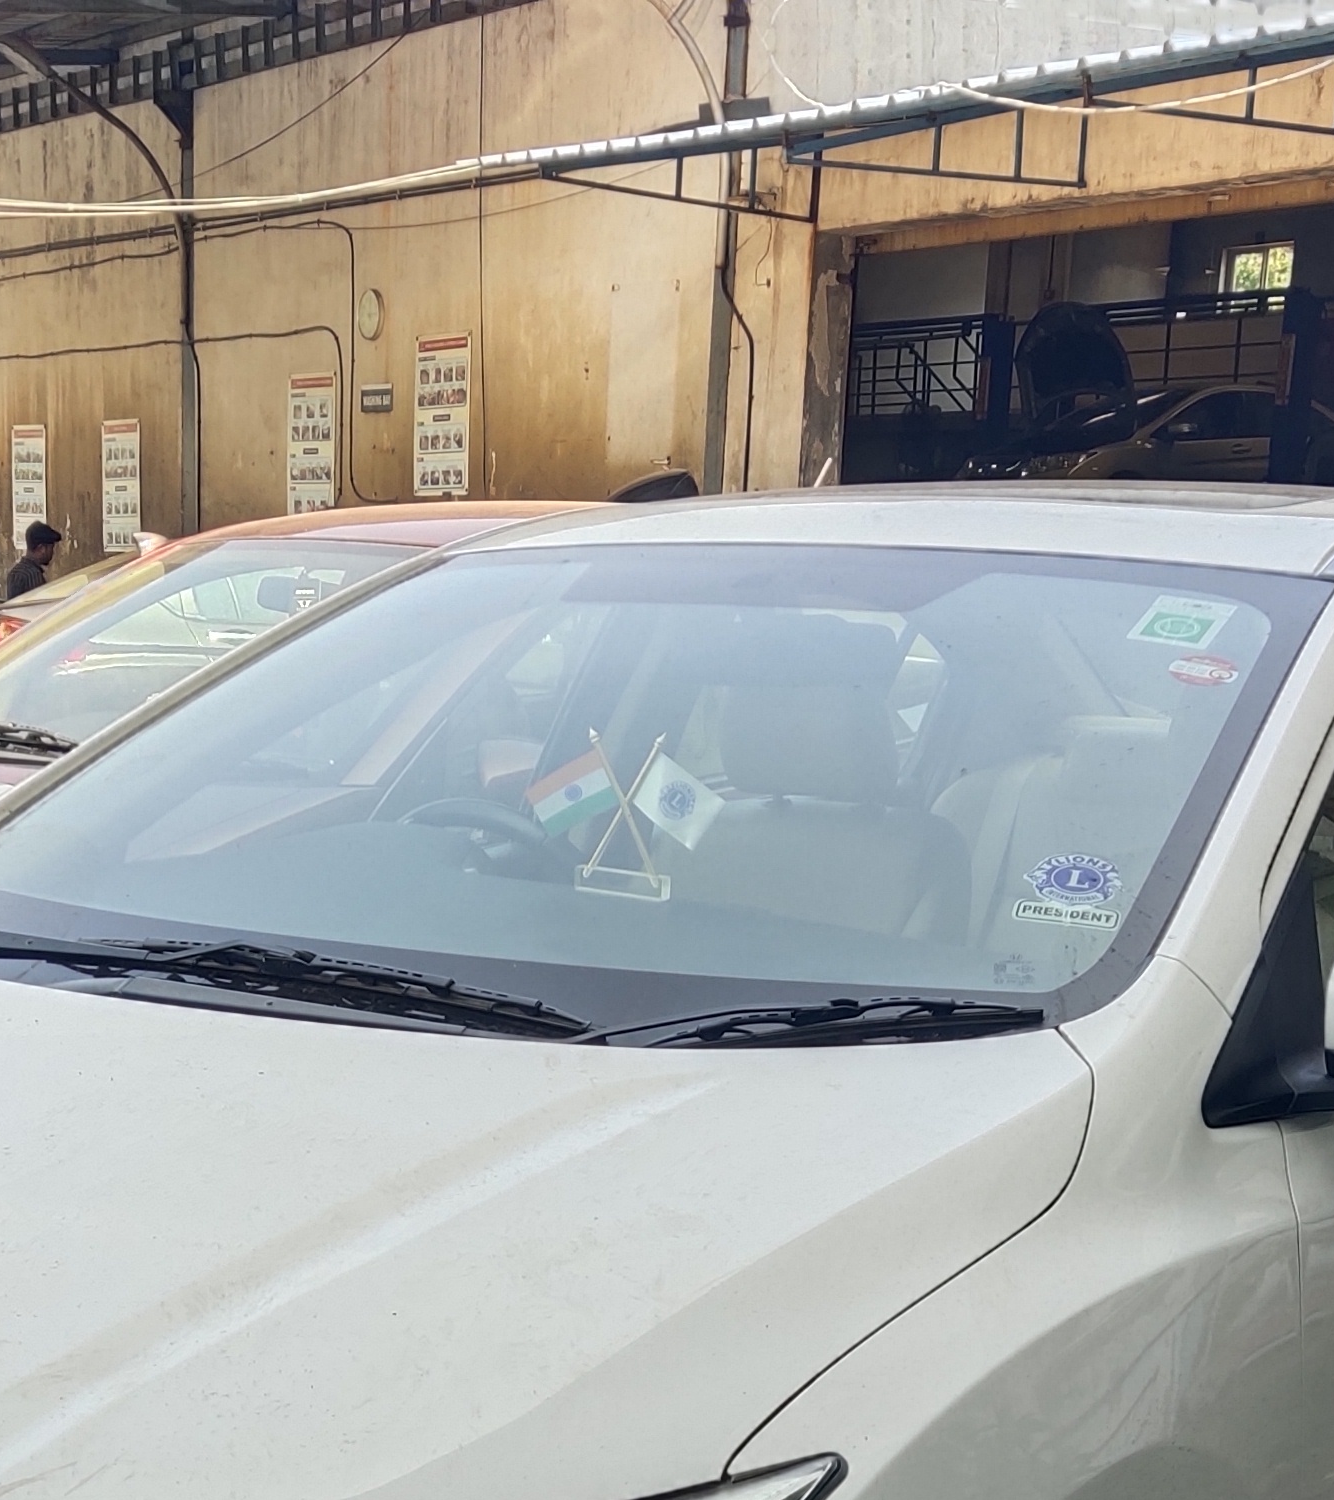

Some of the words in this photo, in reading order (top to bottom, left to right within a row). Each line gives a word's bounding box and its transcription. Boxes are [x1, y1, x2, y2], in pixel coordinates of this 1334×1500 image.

[1054, 856, 1109, 870] LIONS
[1066, 869, 1089, 888] L
[1021, 904, 1114, 924] PRESIDENT
